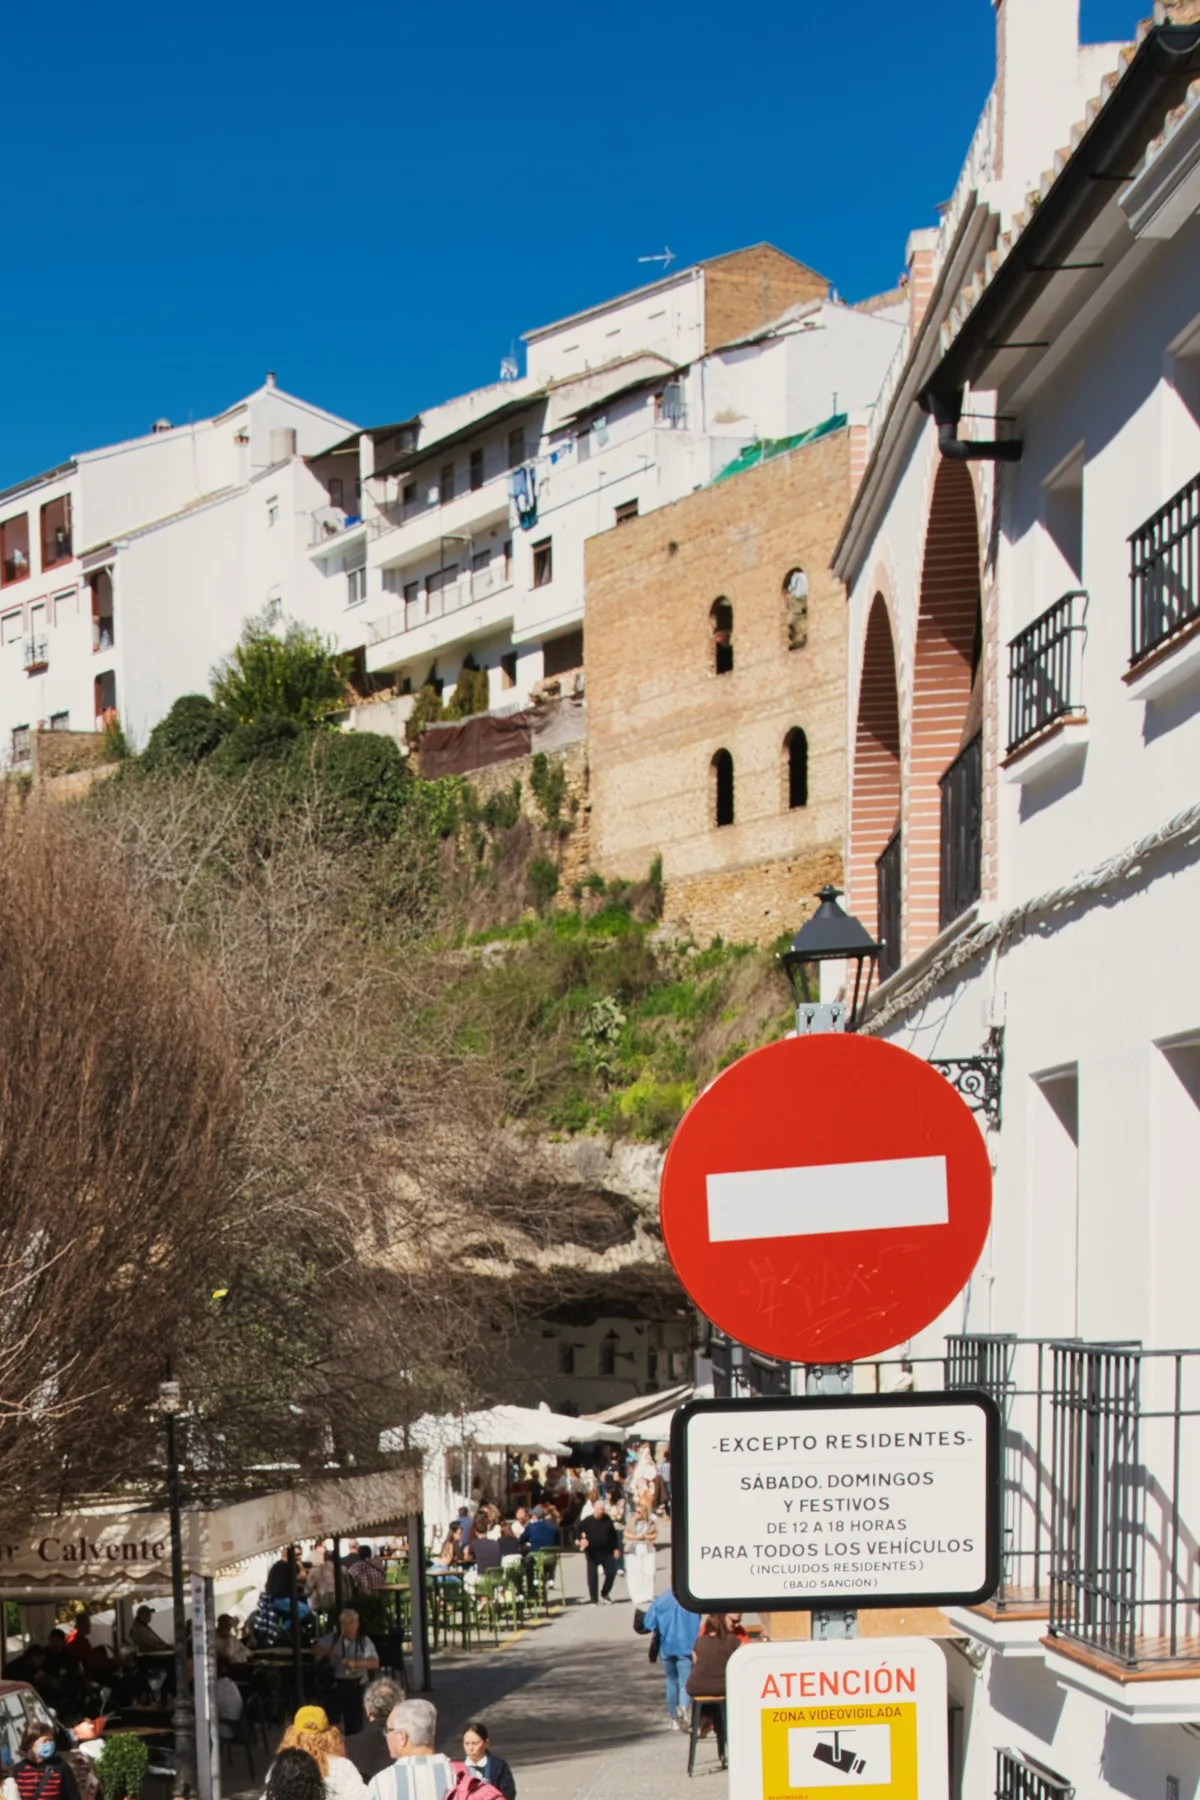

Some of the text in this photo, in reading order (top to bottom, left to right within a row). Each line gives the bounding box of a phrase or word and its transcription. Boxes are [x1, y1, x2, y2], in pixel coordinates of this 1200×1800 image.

[713, 1431, 972, 1452] -EXCEPTO RESIDENTES-
[741, 1472, 933, 1490] SÁBADO, DOMINGOS
[784, 1497, 889, 1512] Y FESTIVOS
[767, 1519, 906, 1534] DE 12 A 18 HORAS
[38, 1537, 165, 1562] Calvente
[701, 1537, 973, 1559] PARA TODOS LOS VEHÍCULOS
[750, 1560, 923, 1575] (INCLUIDOS RESIDENTES)
[784, 1578, 877, 1589] (BAJO SANCIÓN)
[761, 1662, 915, 1698] ATENCIÓN
[772, 1706, 902, 1722] ZONA VIDEOVIGILADA
